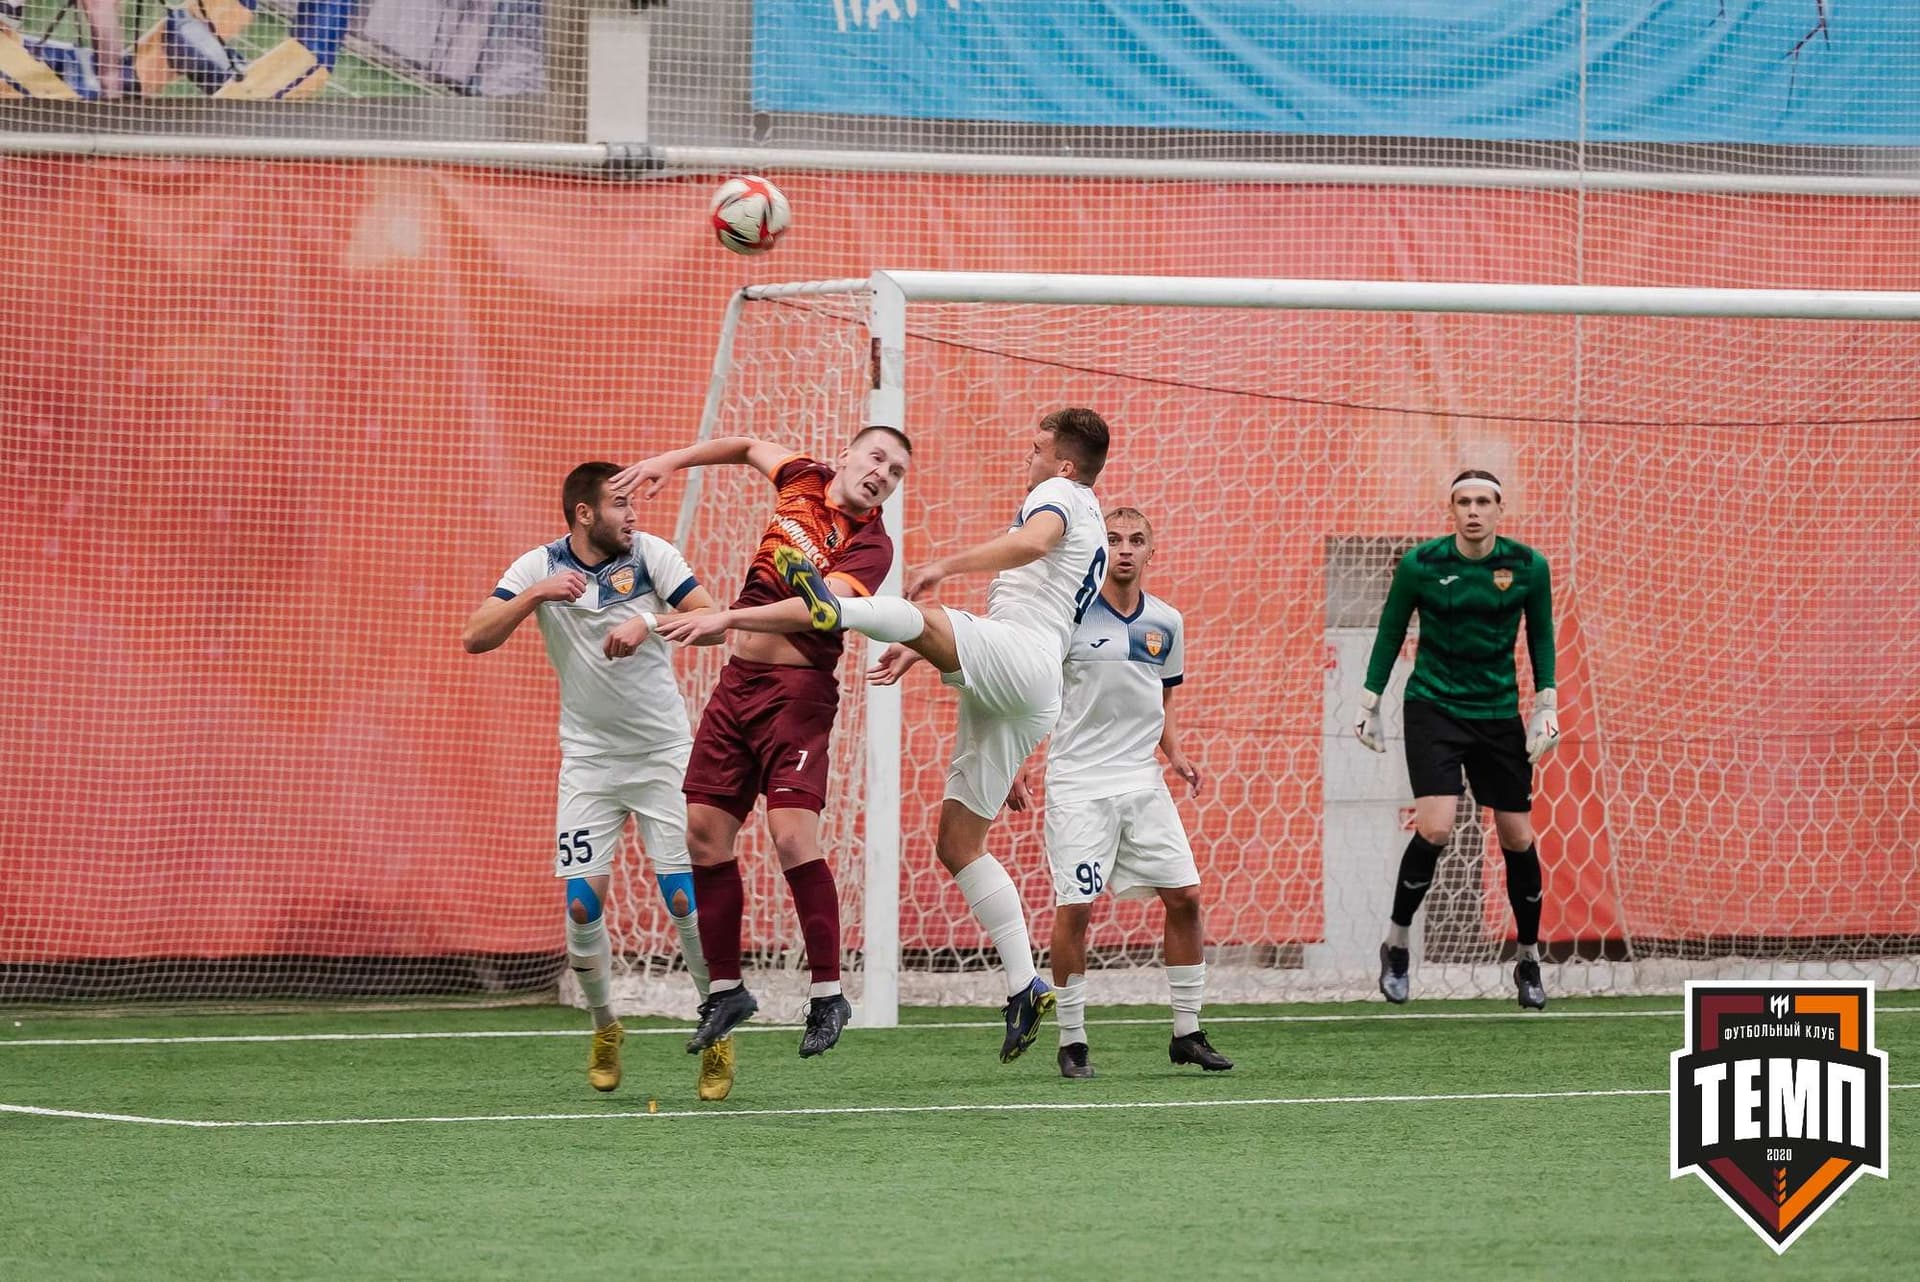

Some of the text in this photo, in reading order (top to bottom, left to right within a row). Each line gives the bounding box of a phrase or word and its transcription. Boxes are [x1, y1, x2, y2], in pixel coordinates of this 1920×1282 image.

[794, 750, 809, 772] 7
[558, 829, 594, 867] 55
[1075, 863, 1103, 896] 96
